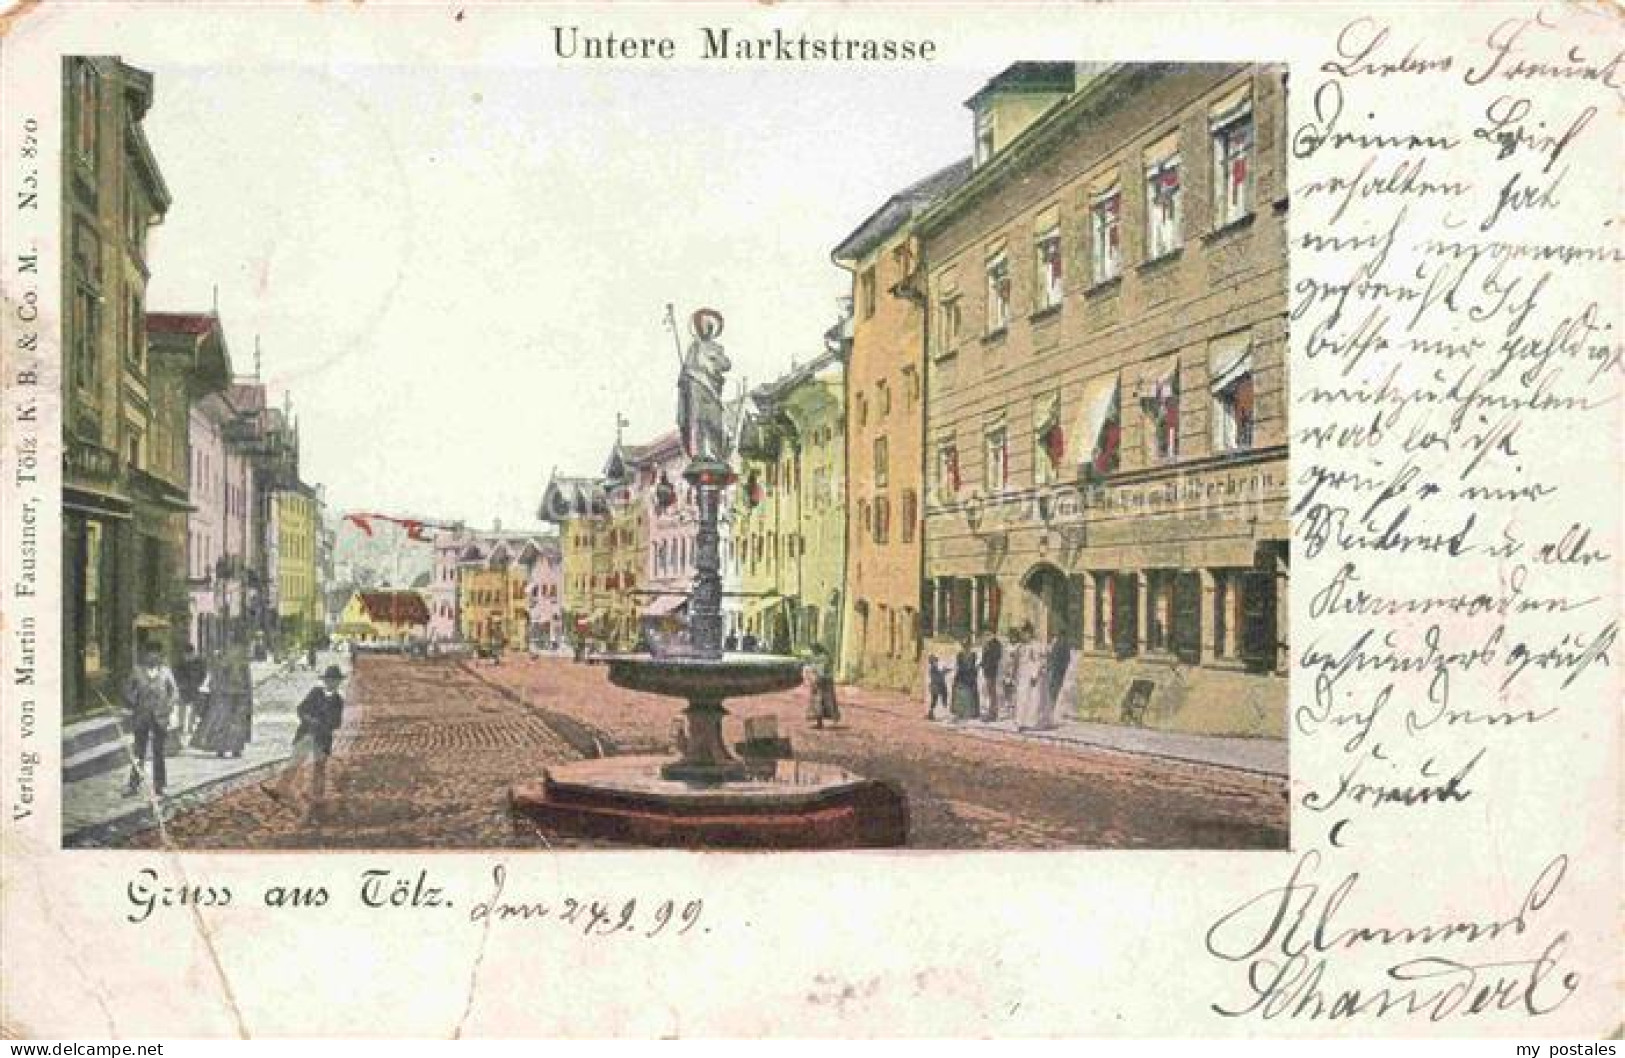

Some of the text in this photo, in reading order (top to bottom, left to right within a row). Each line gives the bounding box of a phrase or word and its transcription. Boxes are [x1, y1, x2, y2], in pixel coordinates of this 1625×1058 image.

[551, 25, 938, 61] Untere Marktstrasse
[17, 331, 38, 352] &
[15, 617, 36, 685] Martin
[20, 700, 37, 739] von
[13, 751, 40, 821] Verlag
[126, 868, 454, 923] Gruss aus Tölz.
